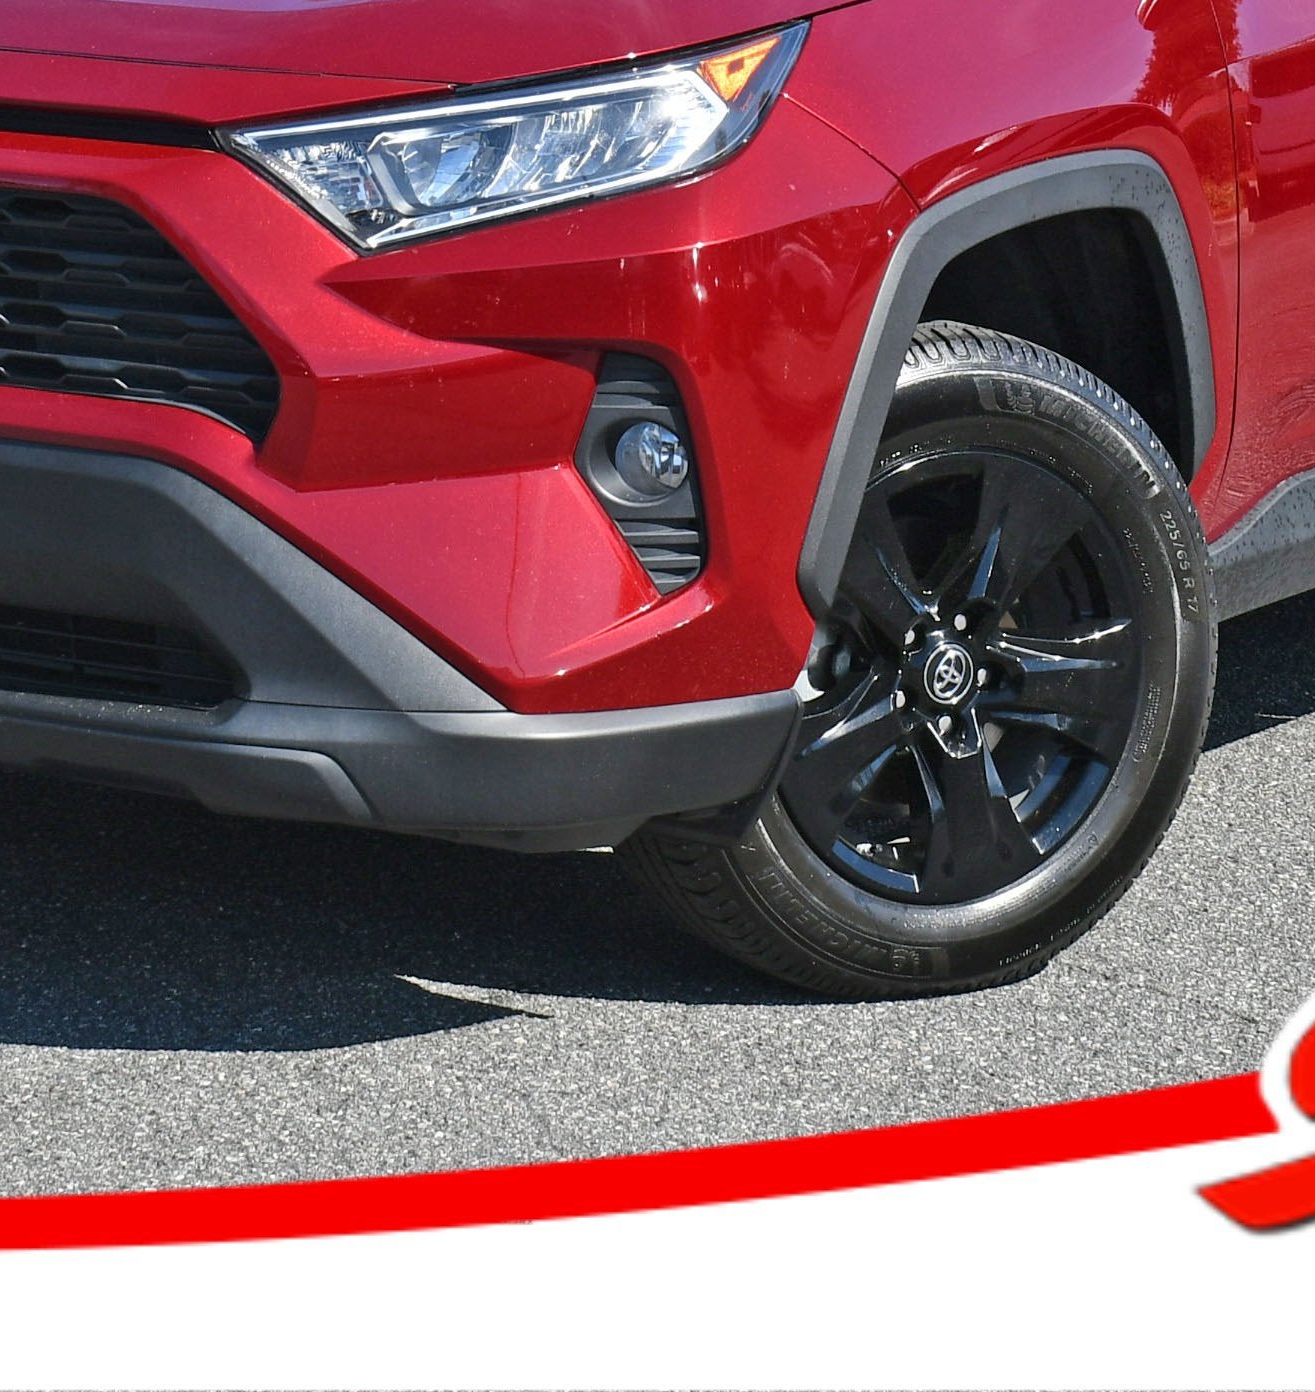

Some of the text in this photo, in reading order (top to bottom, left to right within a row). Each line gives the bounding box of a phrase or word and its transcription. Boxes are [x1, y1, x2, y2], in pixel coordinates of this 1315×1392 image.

[1036, 390, 1160, 499] MICHELIN
[1159, 510, 1189, 572] 225/65
[1182, 577, 1195, 589] R
